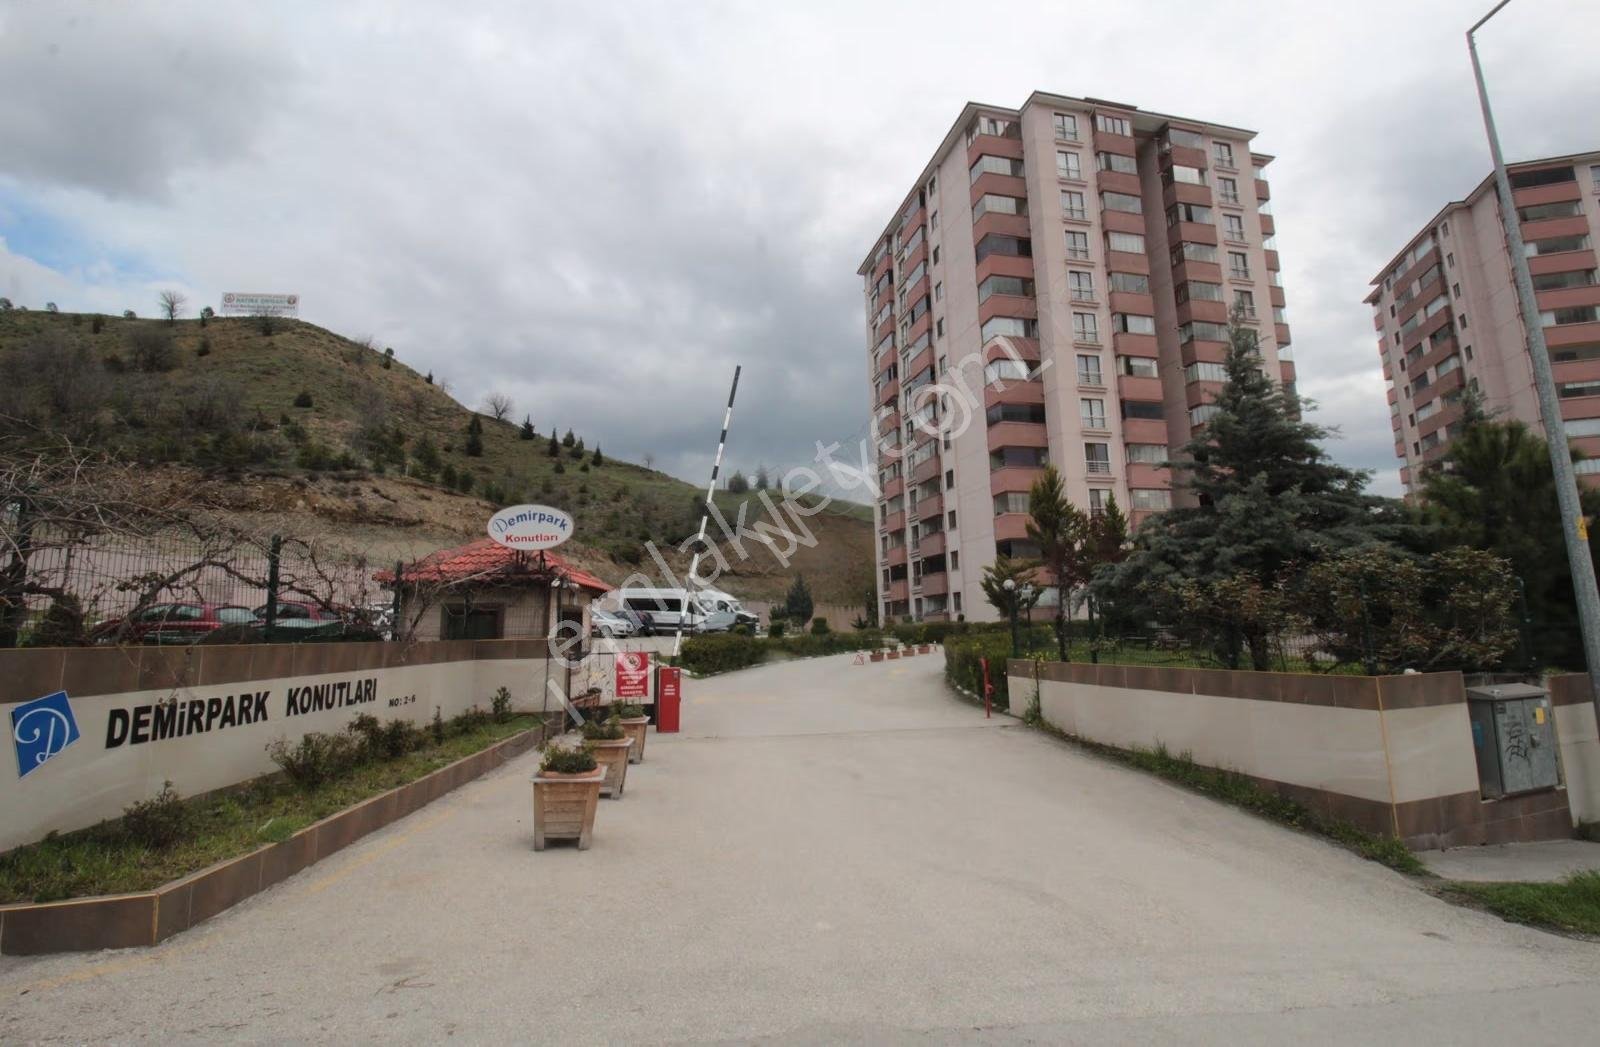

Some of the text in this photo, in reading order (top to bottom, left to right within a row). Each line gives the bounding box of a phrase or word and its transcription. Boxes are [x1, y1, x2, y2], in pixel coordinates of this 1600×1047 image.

[493, 510, 568, 533] Demirpark
[505, 533, 558, 543] Konutları
[286, 679, 378, 716] KONUTLARI
